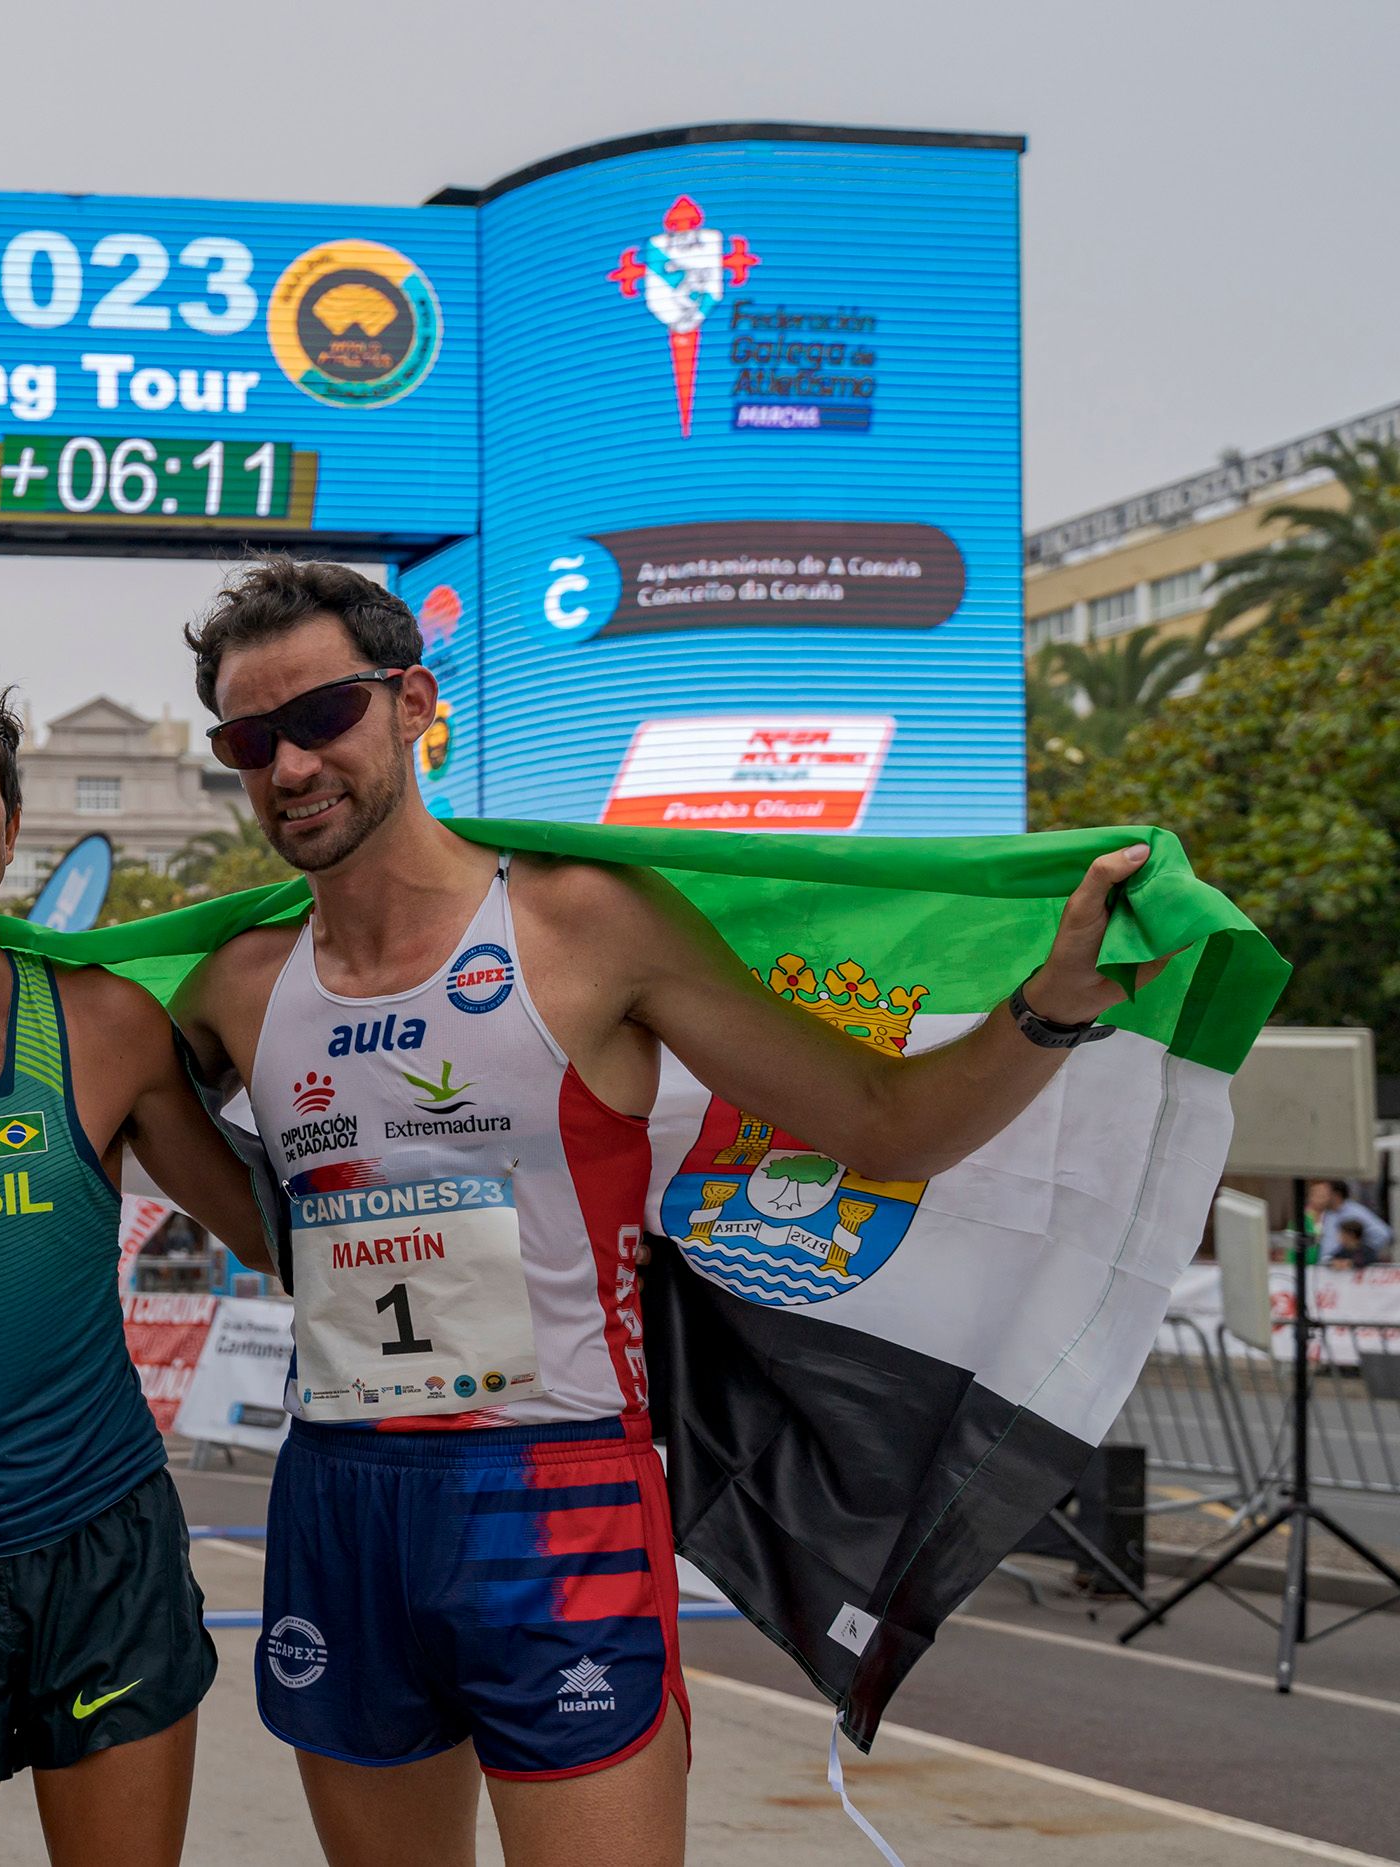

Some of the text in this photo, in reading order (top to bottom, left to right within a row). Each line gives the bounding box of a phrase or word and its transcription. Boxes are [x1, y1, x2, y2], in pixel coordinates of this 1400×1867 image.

[732, 335, 845, 371] Galega
[81, 353, 261, 413] Tour
[637, 555, 922, 585] Ayuntamiento de A Coruña
[637, 578, 845, 607] Concello da Coruña
[663, 799, 825, 821] Prueba Oficial
[457, 968, 505, 987] CAPEX
[327, 1013, 427, 1058] aula
[281, 1112, 358, 1149] DIPUTACIÓN
[384, 1114, 512, 1139] Extremadura
[285, 1130, 359, 1164] DE BADAJOZ
[302, 1179, 505, 1224] CANTONES23
[332, 1226, 446, 1269] MARTÍN
[374, 1283, 434, 1356] 1
[275, 1641, 316, 1660] CAPEX
[557, 1696, 617, 1713] luanvi
